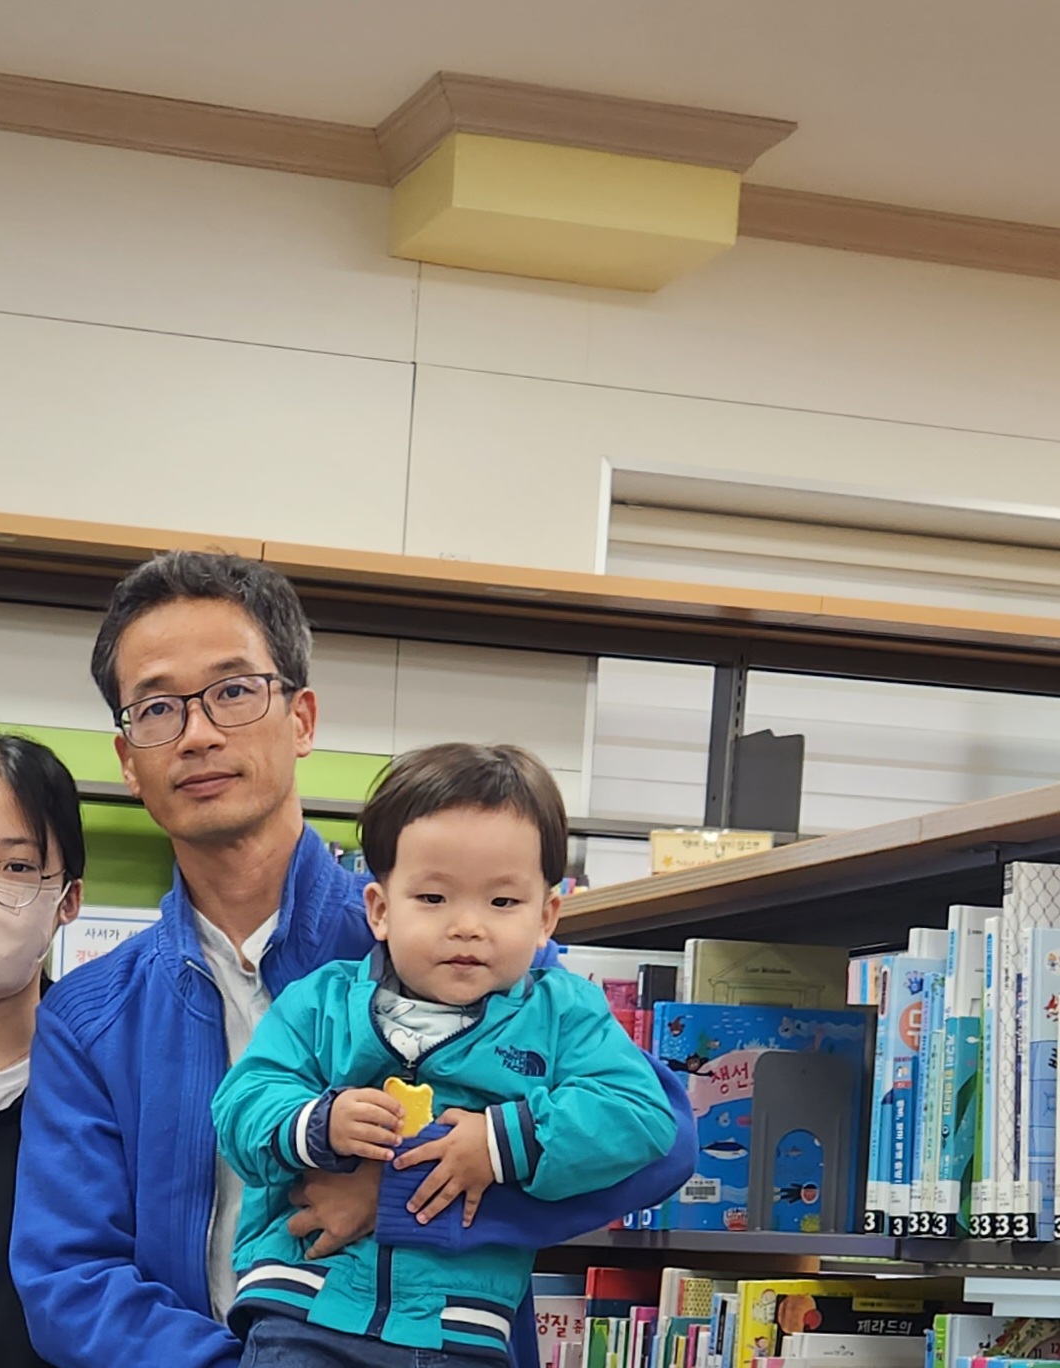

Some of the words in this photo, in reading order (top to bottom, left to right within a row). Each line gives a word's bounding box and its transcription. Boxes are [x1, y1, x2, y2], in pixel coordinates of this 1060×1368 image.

[85, 928, 120, 940] 사서가
[711, 1062, 751, 1095] 생선
[864, 1212, 875, 1230] 3
[893, 1218, 903, 1235] 3
[909, 1213, 918, 1231] 3
[920, 1213, 930, 1232] 3
[936, 1215, 947, 1234] 3
[970, 1216, 980, 1235] 3
[980, 1215, 991, 1235] 3
[996, 1215, 1009, 1236] 3
[1013, 1215, 1029, 1236] 3
[536, 1313, 569, 1338] 성질
[857, 1319, 913, 1335] 제라드의
